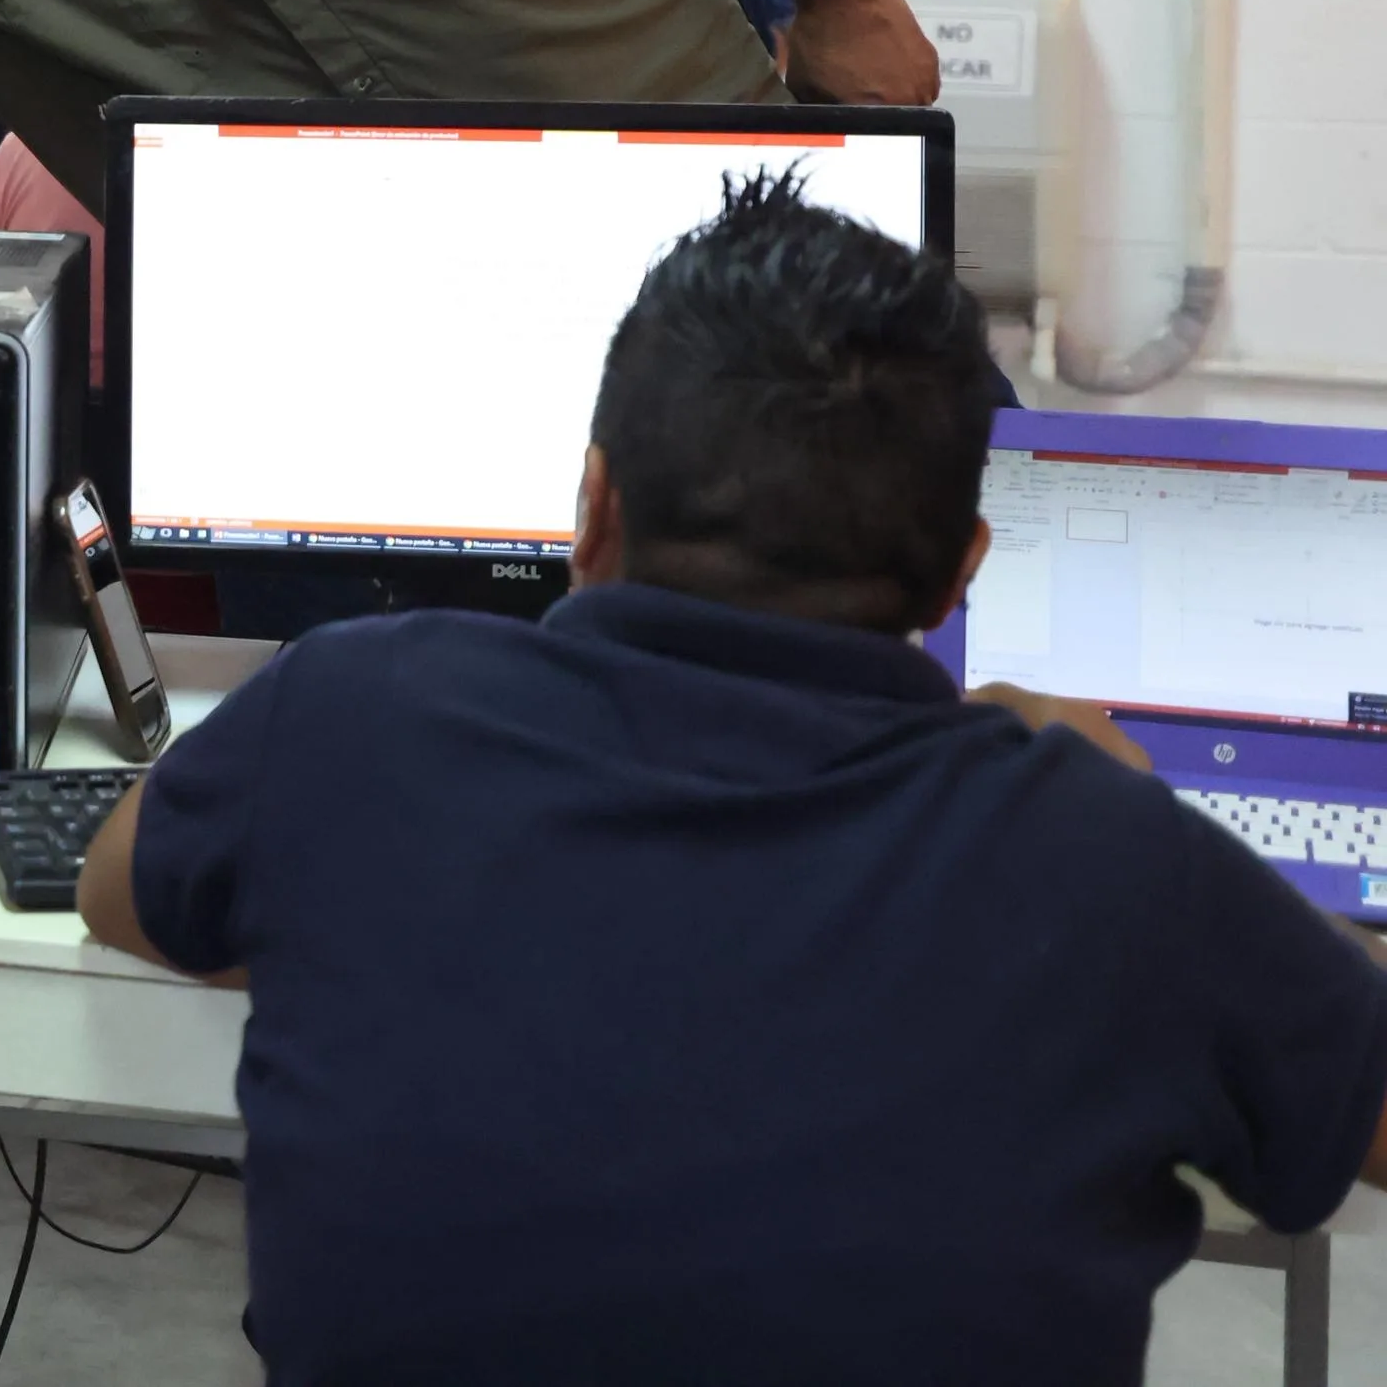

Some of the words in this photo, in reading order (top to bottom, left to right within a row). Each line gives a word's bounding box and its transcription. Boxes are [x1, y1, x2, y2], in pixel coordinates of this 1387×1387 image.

[937, 22, 973, 43] NO
[939, 58, 992, 80] CAR
[492, 563, 541, 580] DELL
[1216, 743, 1234, 763] hp
